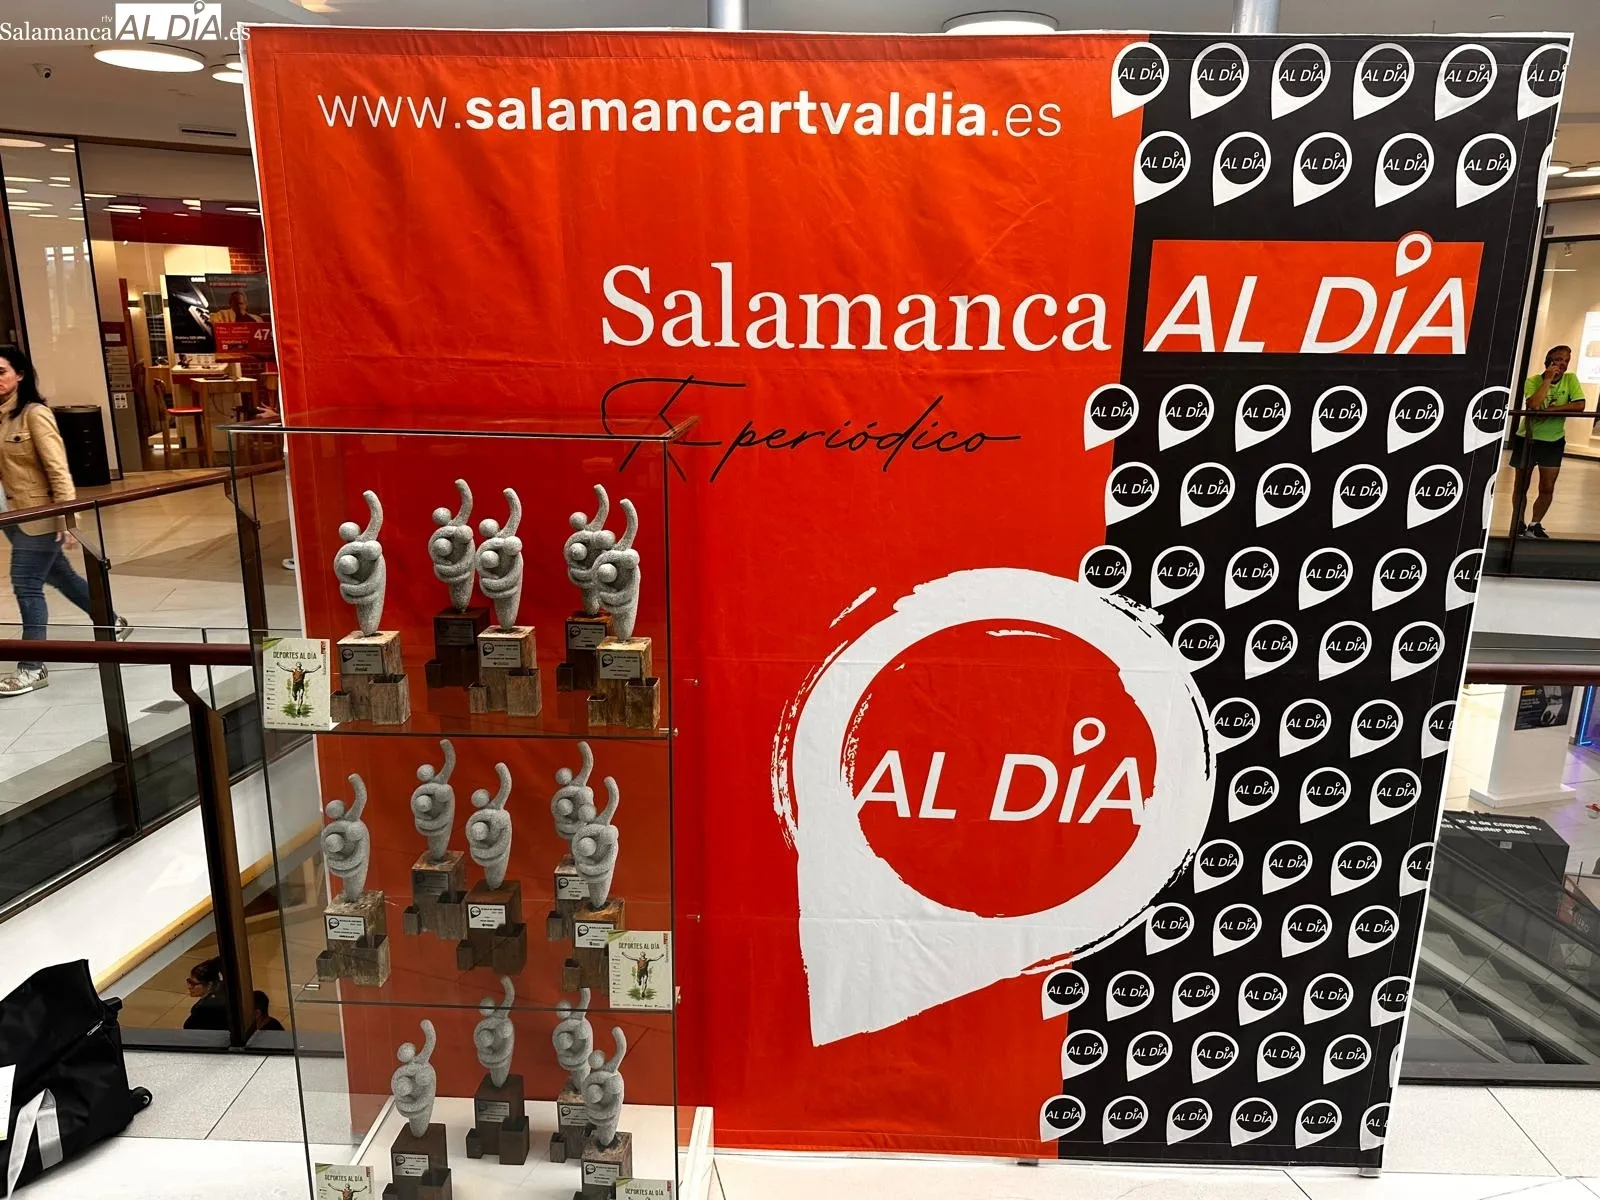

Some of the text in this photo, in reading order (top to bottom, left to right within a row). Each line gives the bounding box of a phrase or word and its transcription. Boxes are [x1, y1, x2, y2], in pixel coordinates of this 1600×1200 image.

[1118, 67, 1136, 81] AL
[1197, 68, 1215, 81] AL
[1278, 69, 1296, 82] AL
[1361, 69, 1379, 82] AL
[1444, 69, 1462, 84] AL
[1527, 69, 1544, 82] AL
[317, 86, 1062, 137] www.salamancartvaldia.es
[1140, 156, 1158, 169] AL
[1220, 157, 1238, 170] AL
[1300, 158, 1318, 171] AL
[1383, 158, 1400, 171] AL
[1464, 159, 1482, 172] AL
[601, 261, 1112, 353] Salamanca
[1143, 274, 1265, 354] AL
[1090, 406, 1107, 418] AL
[1165, 406, 1182, 418] AL
[1242, 407, 1259, 419] AL
[1318, 408, 1335, 419] AL
[1395, 409, 1411, 420] AL
[1472, 408, 1488, 420] AL
[710, 395, 1021, 483] periódico
[1111, 483, 1128, 495] AL
[1187, 484, 1203, 495] AL
[1262, 484, 1279, 496] AL
[1339, 485, 1356, 497] AL
[1414, 486, 1431, 497] AL
[1085, 566, 1101, 576] AL
[1157, 566, 1173, 577] AL
[1231, 567, 1248, 578] AL
[1306, 568, 1322, 579] AL
[1379, 569, 1395, 580] AL
[1454, 570, 1470, 580] AL
[1178, 639, 1194, 649] AL
[1251, 640, 1267, 650] AL
[1325, 641, 1342, 651] AL
[1398, 642, 1414, 652] AL
[300, 652, 306, 660] AL
[1214, 717, 1230, 727] AL
[1286, 718, 1301, 728] AL
[1357, 719, 1372, 729] AL
[1428, 720, 1444, 730] AL
[854, 750, 956, 819] AL
[1234, 785, 1250, 795] AL
[1306, 786, 1321, 796] AL
[1376, 787, 1392, 797] AL
[1200, 857, 1215, 867] AL
[1268, 858, 1284, 868] AL
[1337, 859, 1353, 869] AL
[1406, 860, 1422, 870] AL
[1151, 920, 1166, 929] AL
[1219, 921, 1233, 931] AL
[1287, 922, 1303, 932] AL
[1355, 923, 1370, 932] AL
[618, 942, 642, 950] DEPORTES
[1047, 986, 1061, 995] AL
[1111, 987, 1126, 997] AL
[1178, 989, 1193, 998] AL
[1244, 990, 1259, 1000] AL
[1309, 990, 1325, 1000] AL
[1377, 992, 1392, 1002] AL
[1066, 1046, 1081, 1056] AL
[1132, 1048, 1146, 1058] AL
[1197, 1048, 1212, 1059] AL
[1263, 1048, 1277, 1059] AL
[1329, 1051, 1343, 1061] AL
[1045, 1110, 1059, 1119] AL
[1108, 1112, 1122, 1121] AL
[1172, 1113, 1186, 1123] AL
[1235, 1113, 1250, 1122] AL
[1301, 1116, 1315, 1125] AL
[1366, 1118, 1380, 1127] AL
